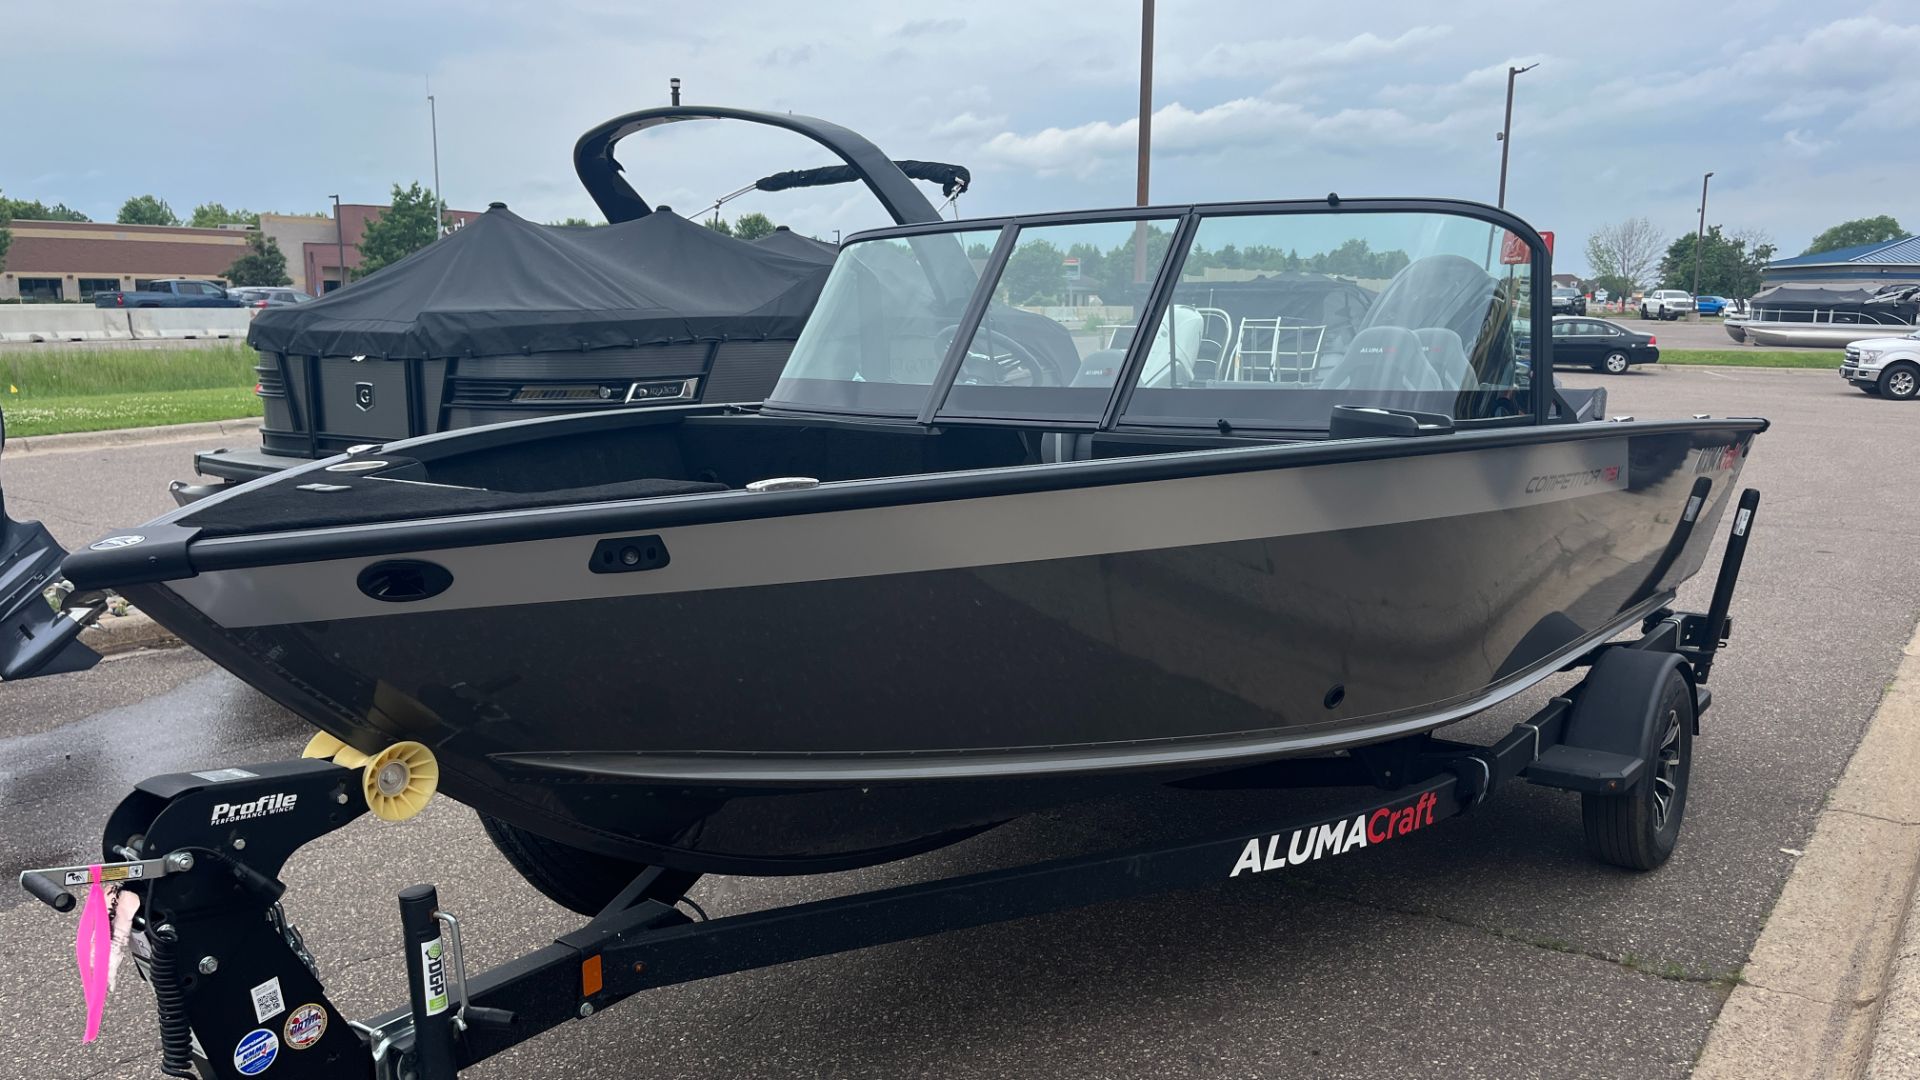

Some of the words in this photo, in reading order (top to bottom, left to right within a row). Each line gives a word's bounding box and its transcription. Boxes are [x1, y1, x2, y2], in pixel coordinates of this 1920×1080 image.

[211, 793, 297, 820] Profile
[211, 811, 267, 826] PERFORMANCE
[269, 805, 294, 814] WINCH
[1229, 791, 1437, 877] ALUMACraft
[428, 959, 444, 996] DGP
